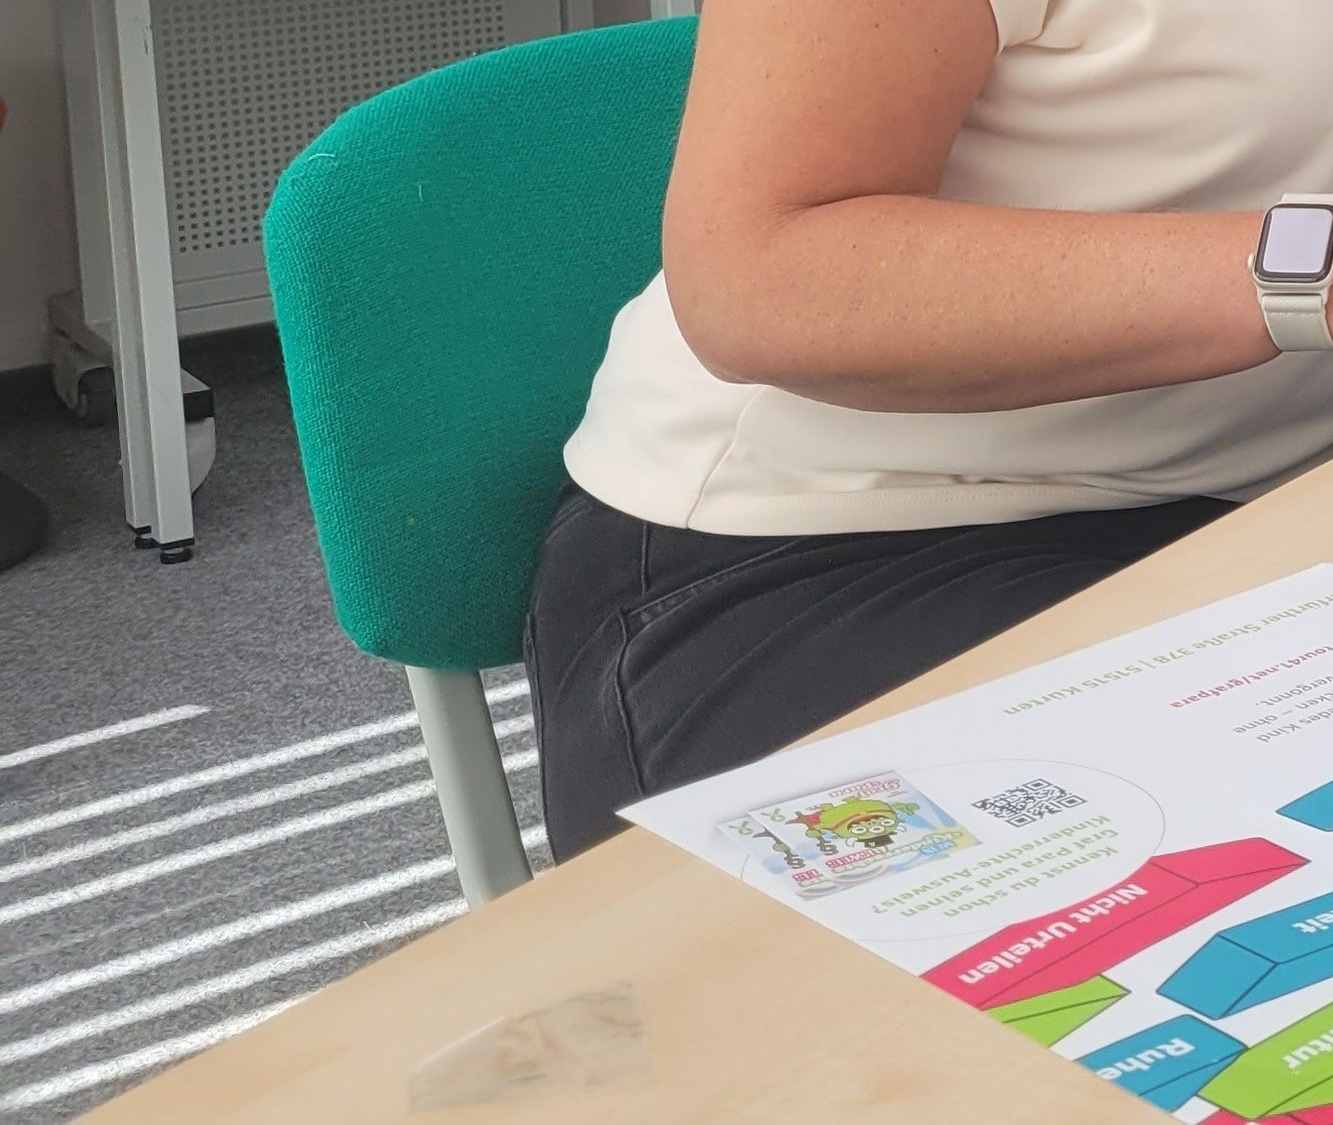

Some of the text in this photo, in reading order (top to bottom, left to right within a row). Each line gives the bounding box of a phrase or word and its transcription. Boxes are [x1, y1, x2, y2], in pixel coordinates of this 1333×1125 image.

[1191, 623, 1262, 649] Straße
[1151, 647, 1195, 664] 378
[1081, 665, 1143, 689] 51515
[1003, 686, 1084, 716] Kürten
[1232, 714, 1279, 734] ohne
[1256, 723, 1302, 743] Kind
[871, 815, 1112, 914] Kinderrechte-Ausweis?
[900, 829, 1119, 917] Graf Para und seinen
[943, 846, 1119, 917] Kennst du schon
[958, 883, 1149, 984] Nicht Urteilen
[1096, 1038, 1195, 1080] Ruhe
